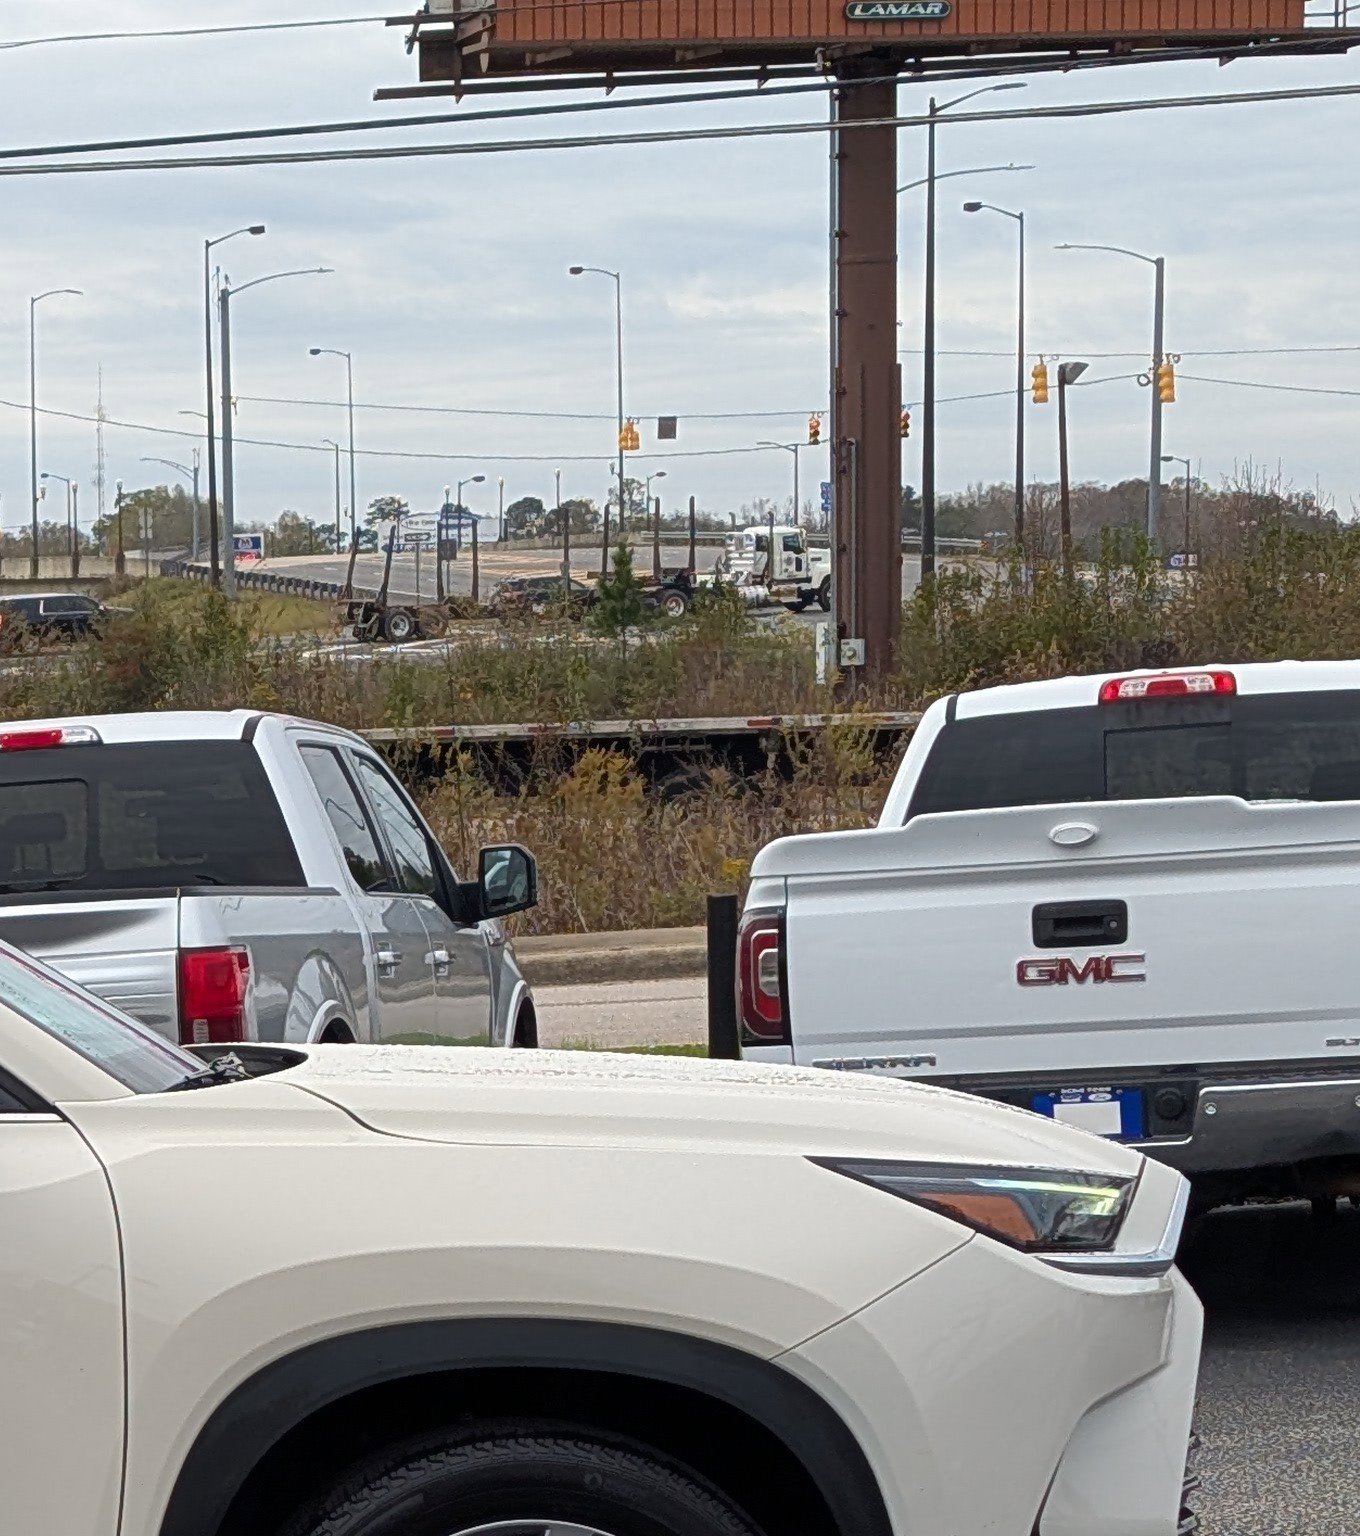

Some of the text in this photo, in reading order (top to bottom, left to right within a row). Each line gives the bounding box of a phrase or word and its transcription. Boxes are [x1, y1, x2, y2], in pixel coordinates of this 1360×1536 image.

[854, 3, 943, 15] LAMAR
[1016, 955, 1146, 987] GMC
[812, 1055, 937, 1071] SIERRA
